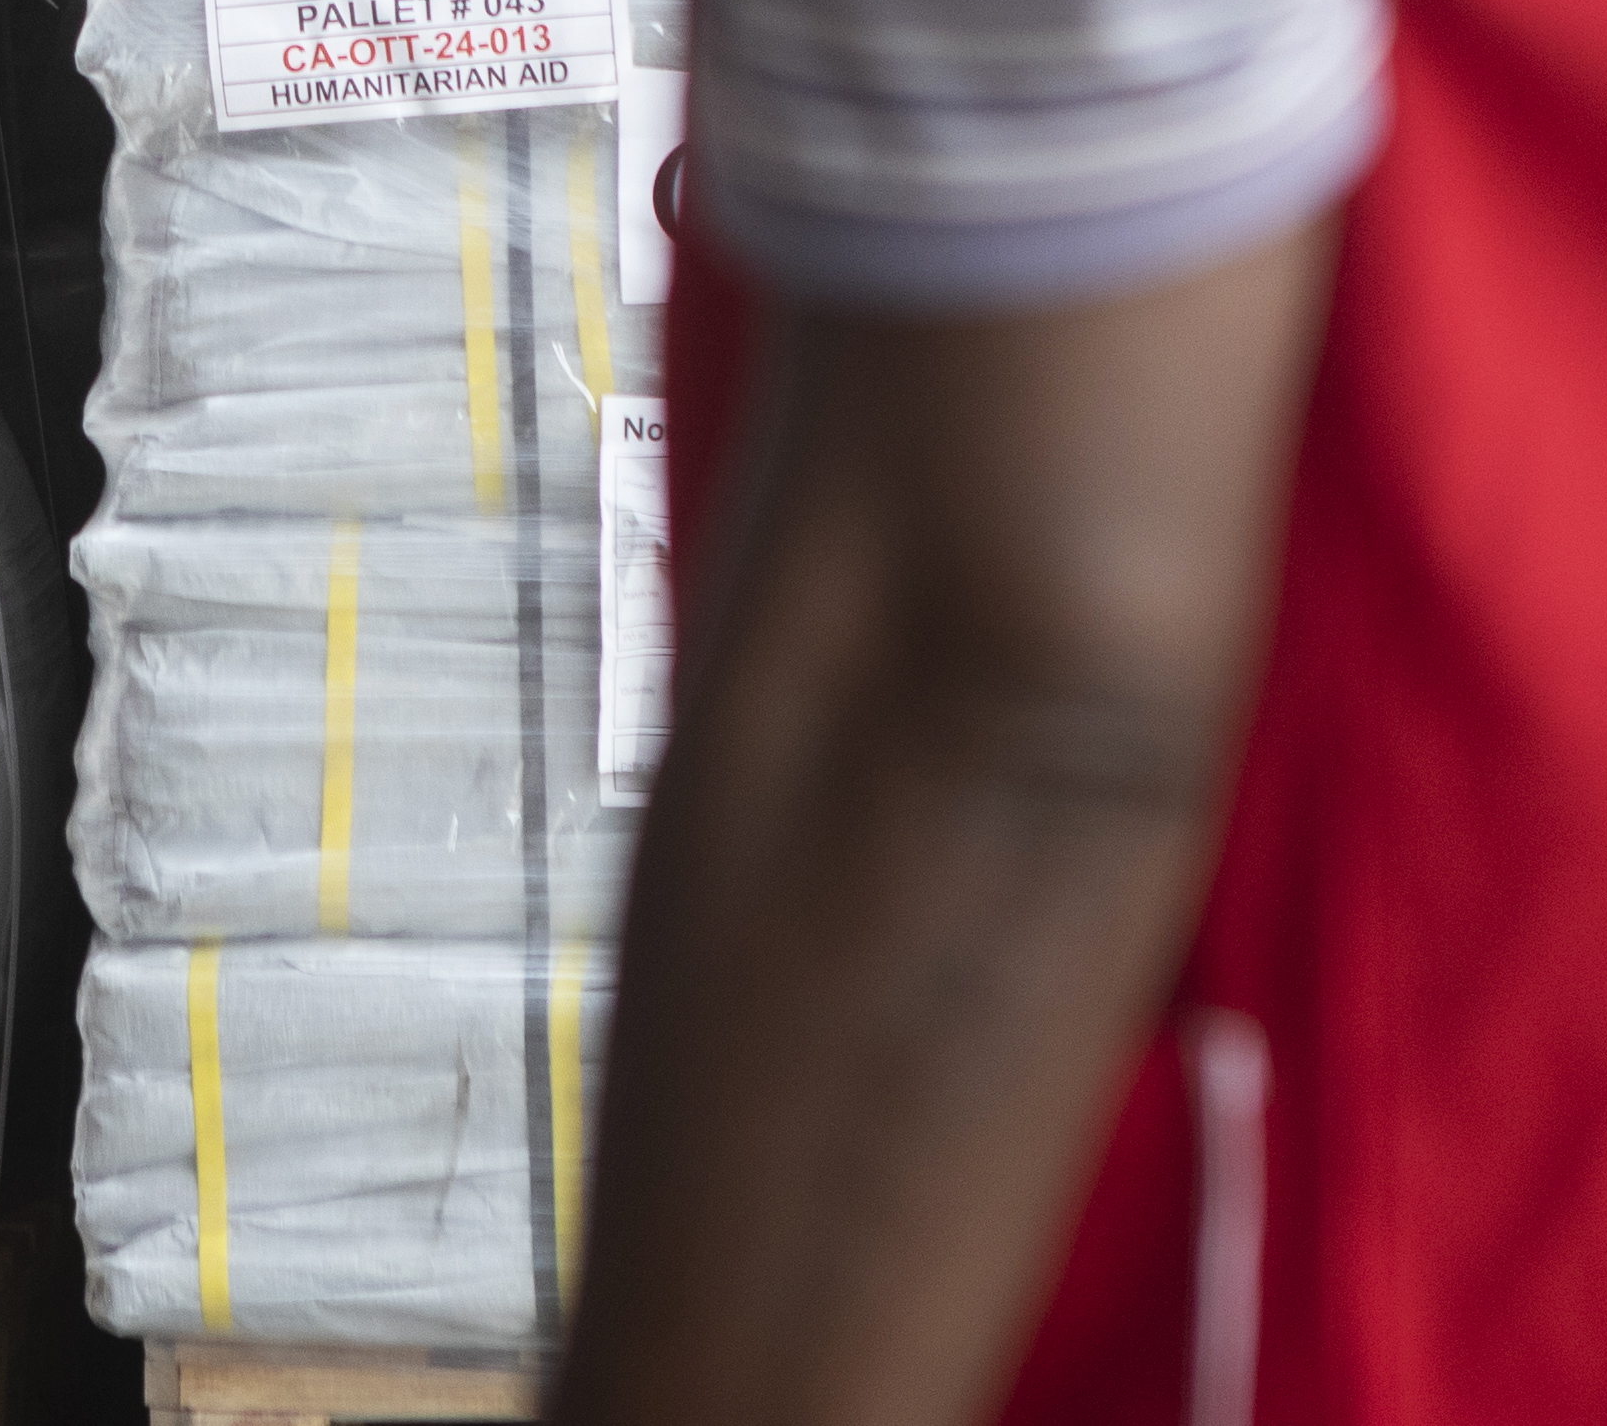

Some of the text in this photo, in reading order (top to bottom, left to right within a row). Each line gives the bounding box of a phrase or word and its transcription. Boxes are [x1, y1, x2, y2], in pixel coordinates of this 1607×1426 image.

[282, 23, 552, 75] CA-OTT-24-013
[271, 60, 570, 109] HUMANITARIAN AID
